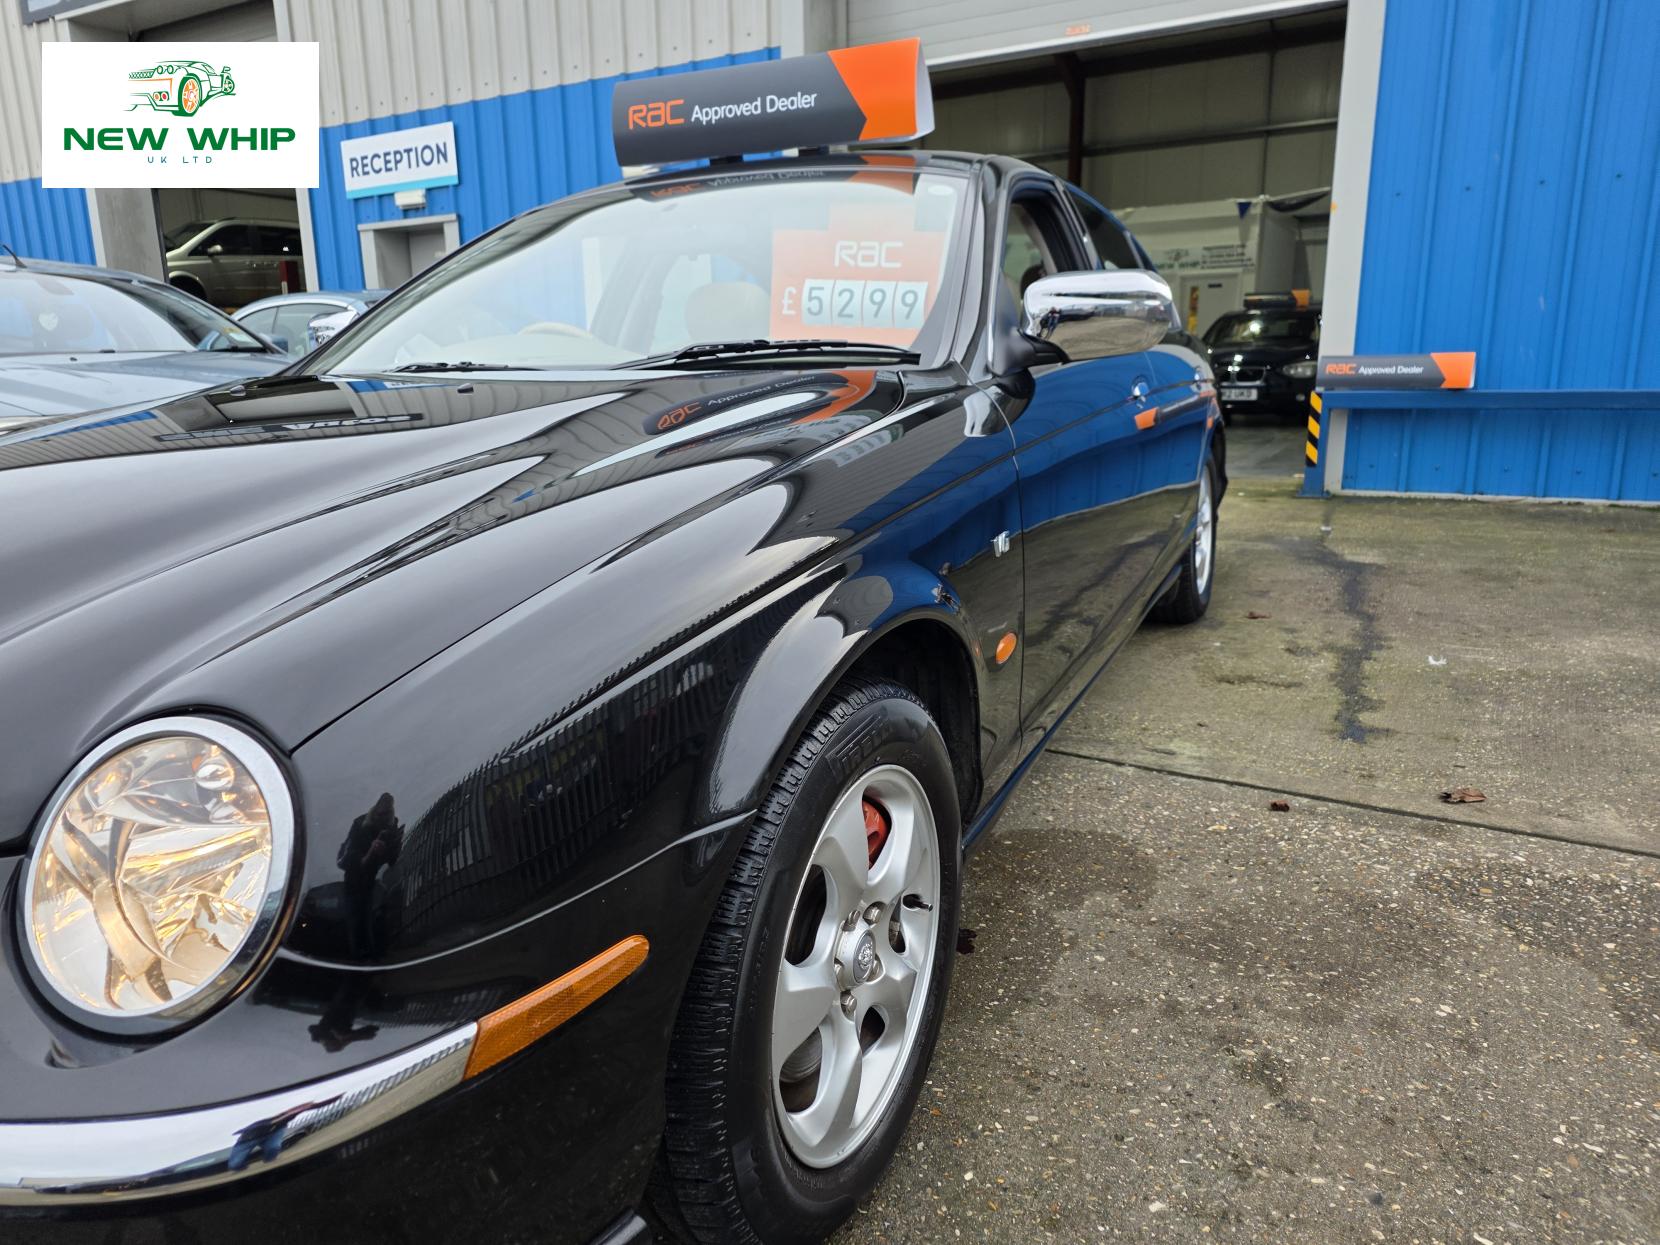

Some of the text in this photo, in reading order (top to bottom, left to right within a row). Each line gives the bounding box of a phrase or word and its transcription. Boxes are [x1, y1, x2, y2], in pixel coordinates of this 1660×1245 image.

[628, 91, 817, 130] RAC Approved Dealer
[349, 141, 449, 178] RECEPTION
[833, 240, 903, 268] RAC
[1358, 365, 1395, 376] Approved
[1397, 364, 1424, 375] Dealer
